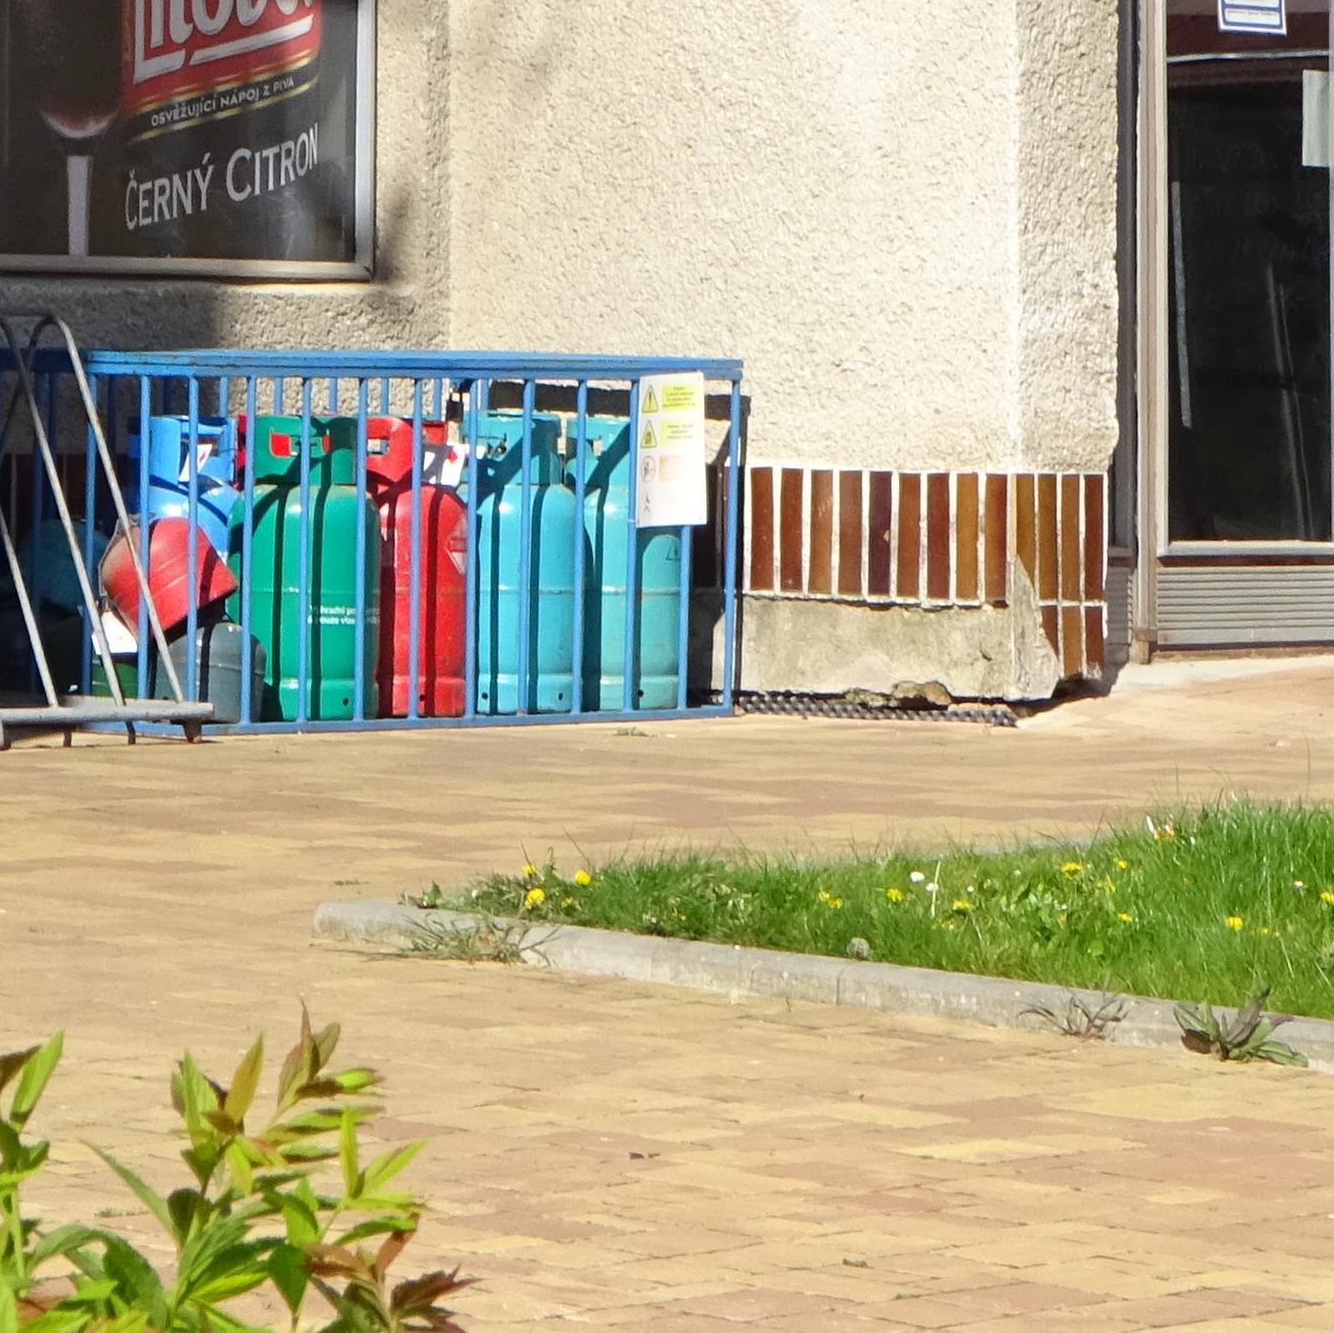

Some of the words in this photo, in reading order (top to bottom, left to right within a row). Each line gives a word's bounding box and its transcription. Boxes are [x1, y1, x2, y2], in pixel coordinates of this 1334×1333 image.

[220, 88, 261, 109] NÁPOJ
[273, 75, 296, 94] PIVA
[125, 151, 214, 231] ČERNÝ
